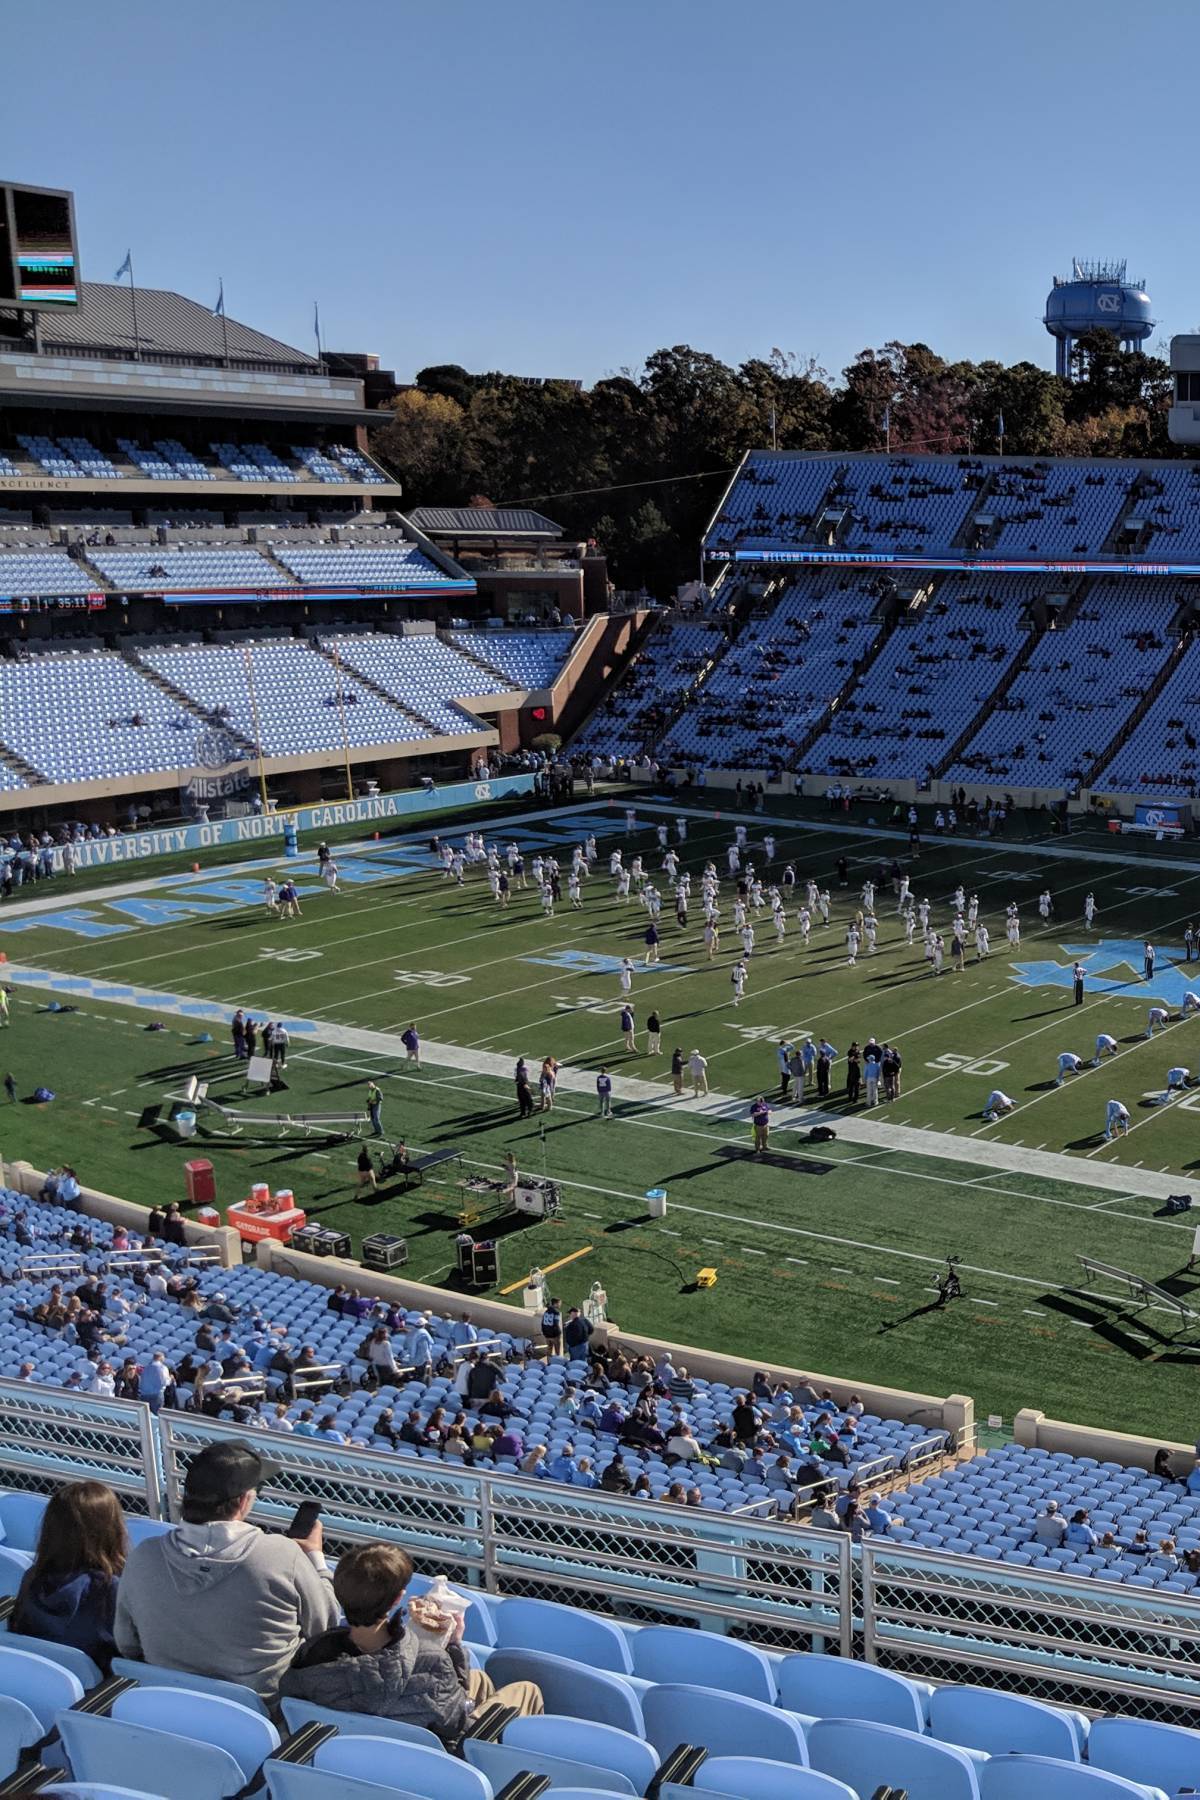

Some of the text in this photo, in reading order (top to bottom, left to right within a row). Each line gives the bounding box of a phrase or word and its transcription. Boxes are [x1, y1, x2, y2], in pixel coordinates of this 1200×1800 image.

[709, 551, 731, 561] 2:29
[21, 597, 31, 612] 0
[57, 597, 87, 608] 35:11
[186, 767, 251, 800] Allstate
[52, 829, 187, 872] UNIVERSITY
[200, 824, 224, 846] OF
[311, 798, 398, 828] CAROLINA
[0, 879, 330, 938] TAR
[258, 947, 324, 962] 10
[394, 970, 472, 987] 20
[556, 996, 635, 1014] 30
[738, 1025, 814, 1043] 40
[924, 1053, 1010, 1076] 50
